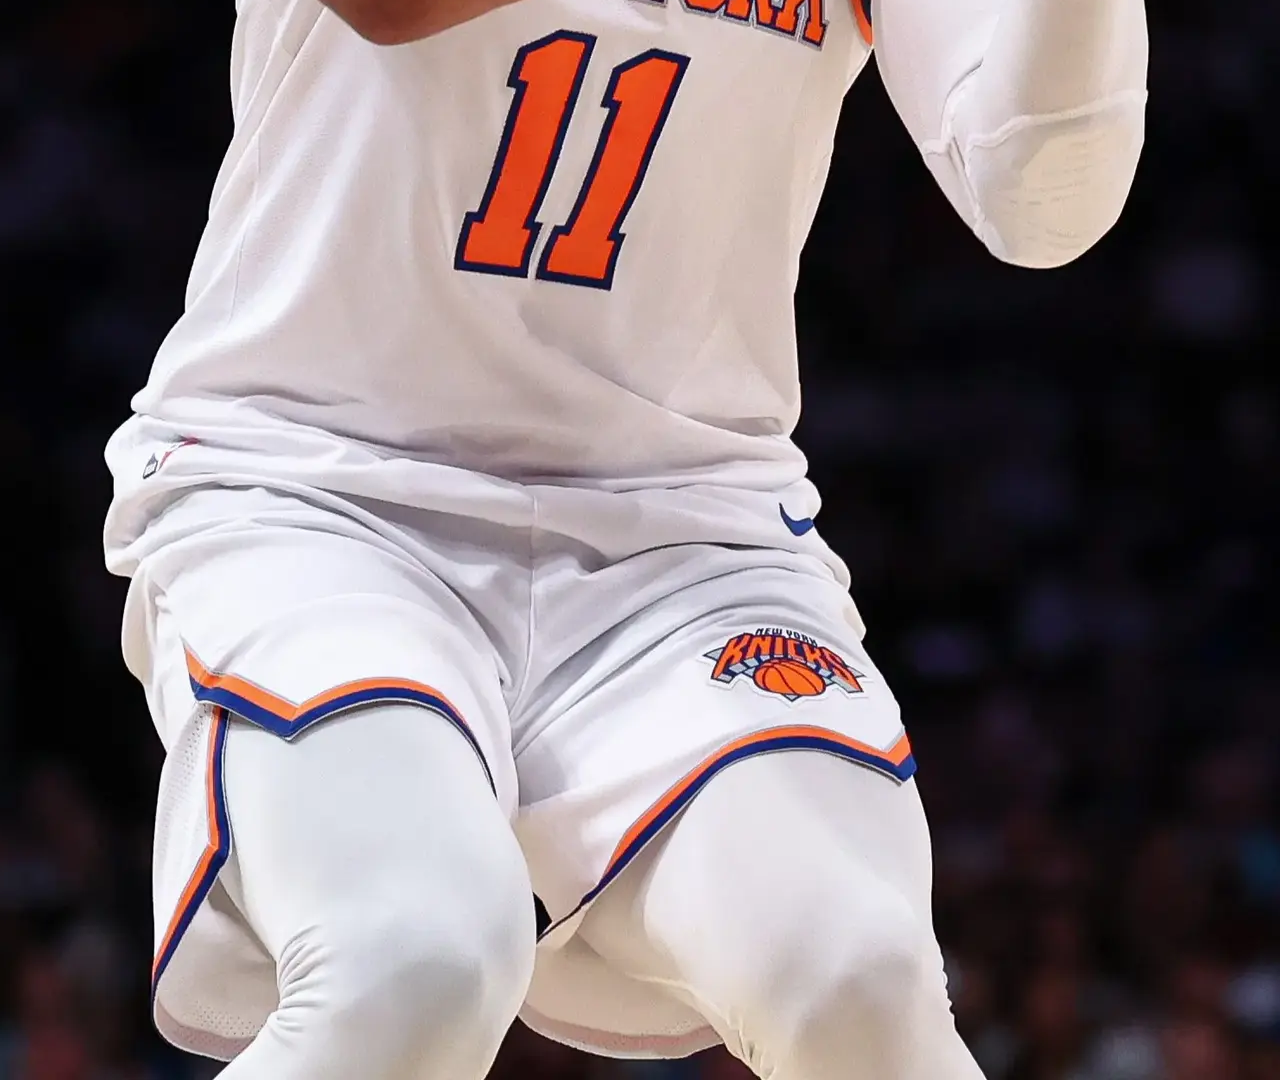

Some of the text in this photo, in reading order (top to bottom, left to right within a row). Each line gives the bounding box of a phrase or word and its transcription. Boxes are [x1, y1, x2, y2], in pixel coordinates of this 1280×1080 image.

[454, 29, 691, 291] 11
[755, 627, 782, 636] NEW
[710, 632, 864, 694] KNICKS
